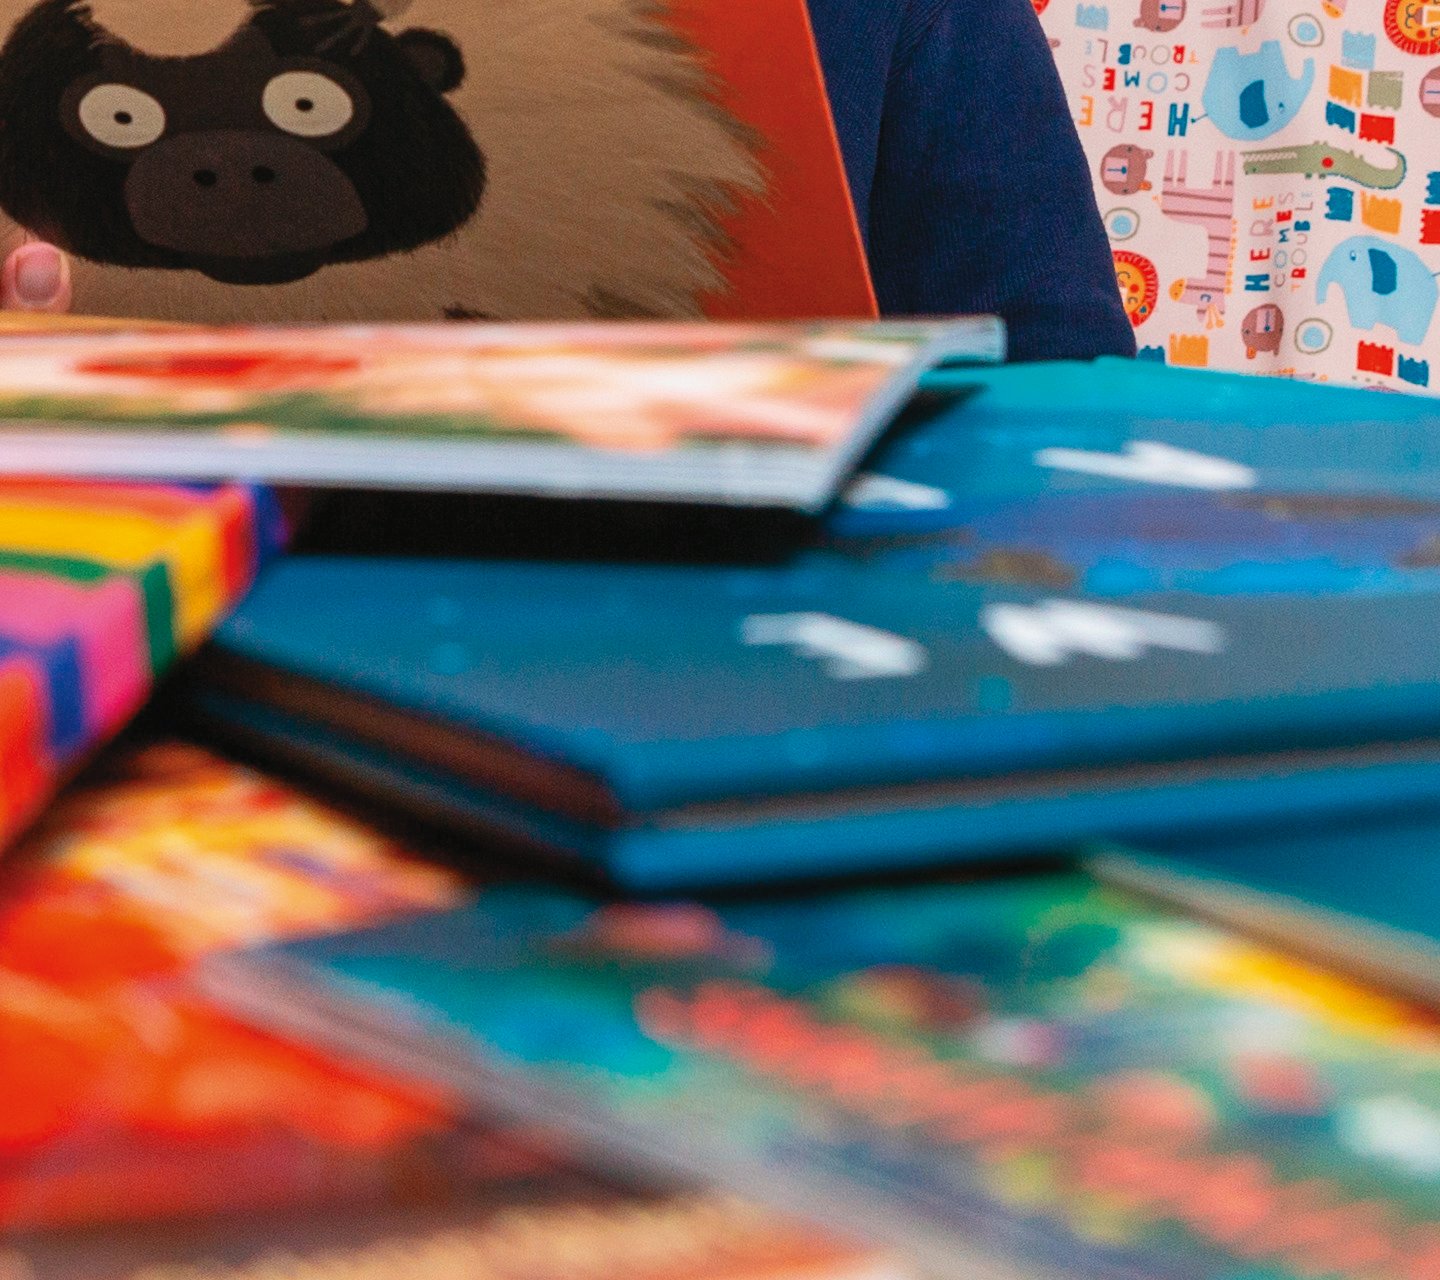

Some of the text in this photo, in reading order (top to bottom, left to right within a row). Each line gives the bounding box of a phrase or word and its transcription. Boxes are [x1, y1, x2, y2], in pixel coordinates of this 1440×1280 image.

[1082, 64, 1191, 94] COMES
[1078, 95, 1190, 138] HERE
[1244, 196, 1274, 292] HERE
[1273, 192, 1294, 288] COMES
